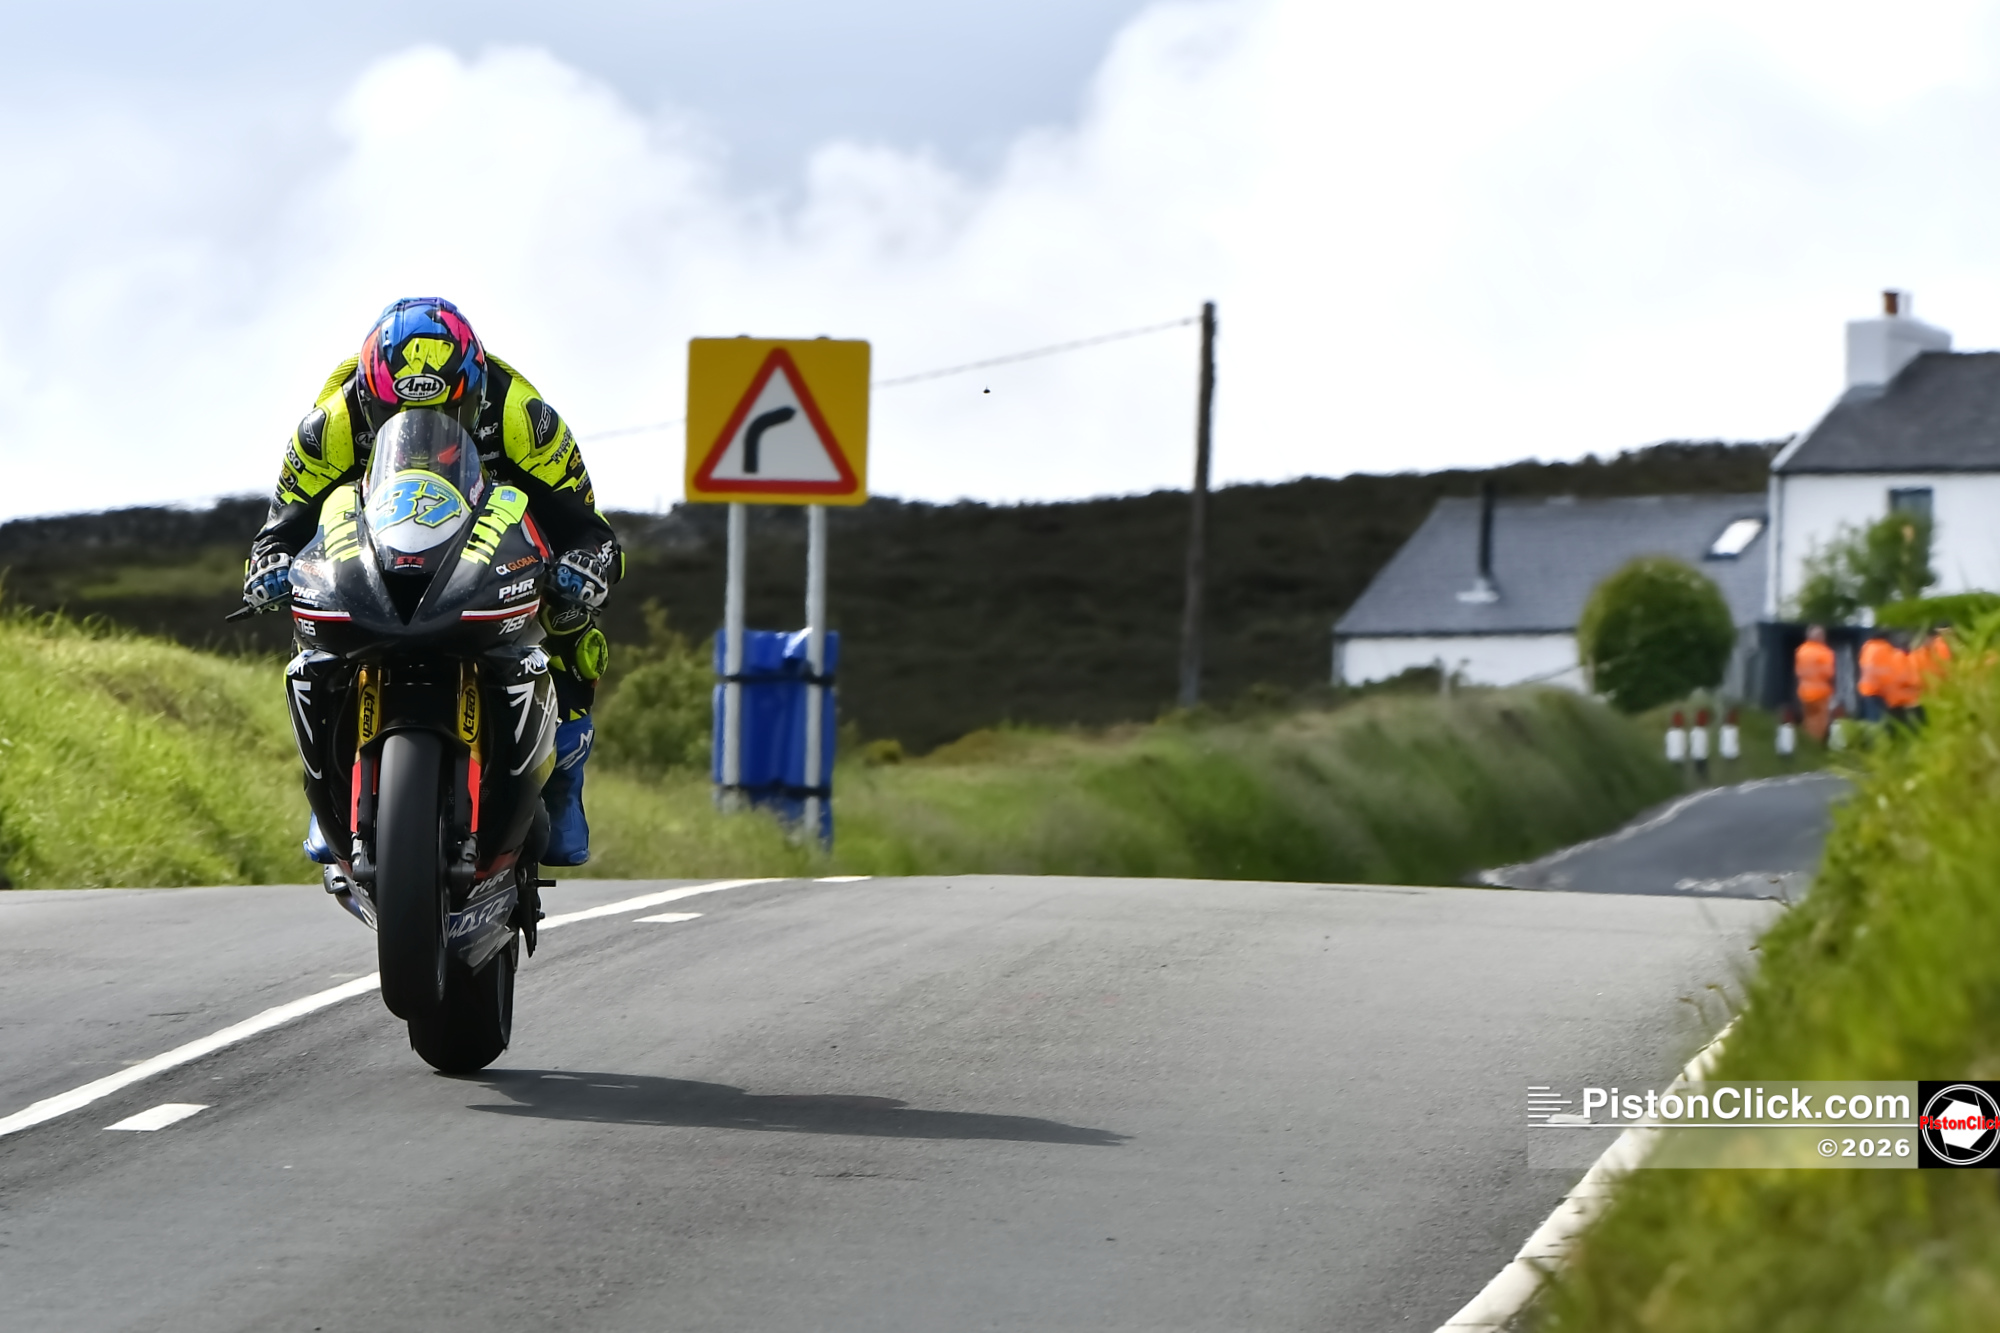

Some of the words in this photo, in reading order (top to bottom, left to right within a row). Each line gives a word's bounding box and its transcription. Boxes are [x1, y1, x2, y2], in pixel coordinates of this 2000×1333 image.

[398, 378, 439, 392] Arai
[374, 480, 461, 535] 37
[396, 556, 425, 565] ETS
[507, 555, 539, 571] GLOBAL
[291, 585, 320, 600] PHR
[498, 578, 535, 600] PHR
[297, 617, 317, 637] 765
